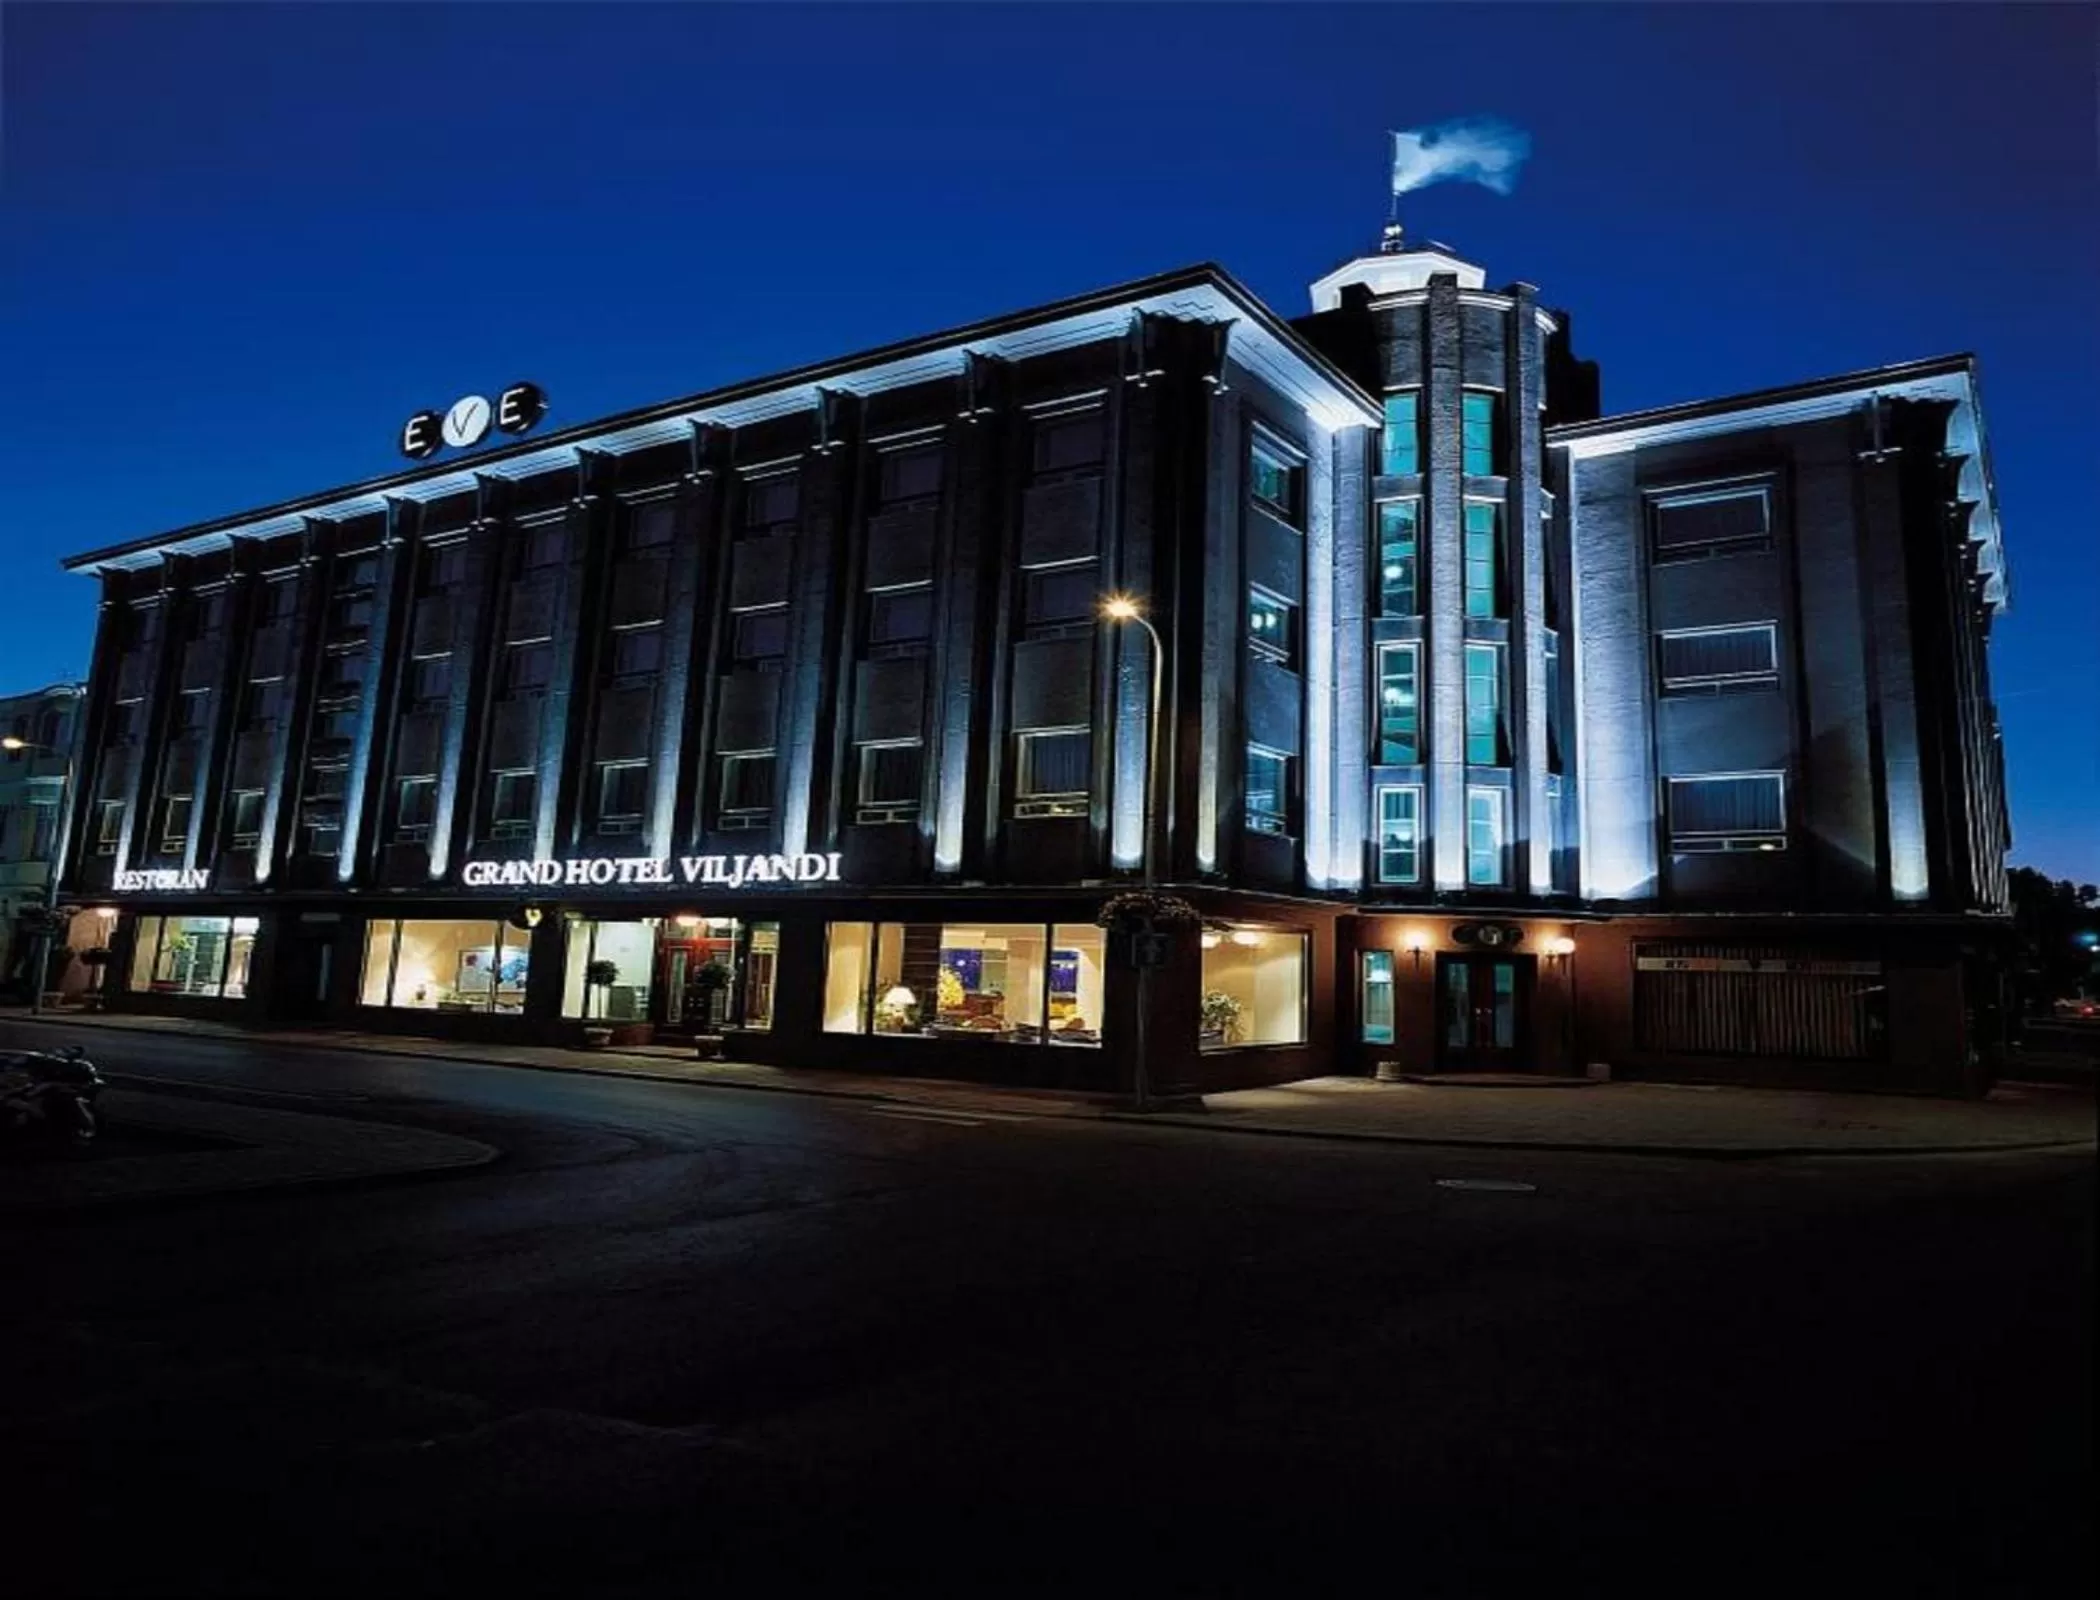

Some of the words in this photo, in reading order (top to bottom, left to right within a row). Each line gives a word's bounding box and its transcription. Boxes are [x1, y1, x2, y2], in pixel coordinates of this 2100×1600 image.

[112, 868, 211, 891] RESTORAN
[463, 860, 563, 886] GRAND
[565, 858, 674, 885] HOTEL
[680, 852, 843, 889] VILJANDI
